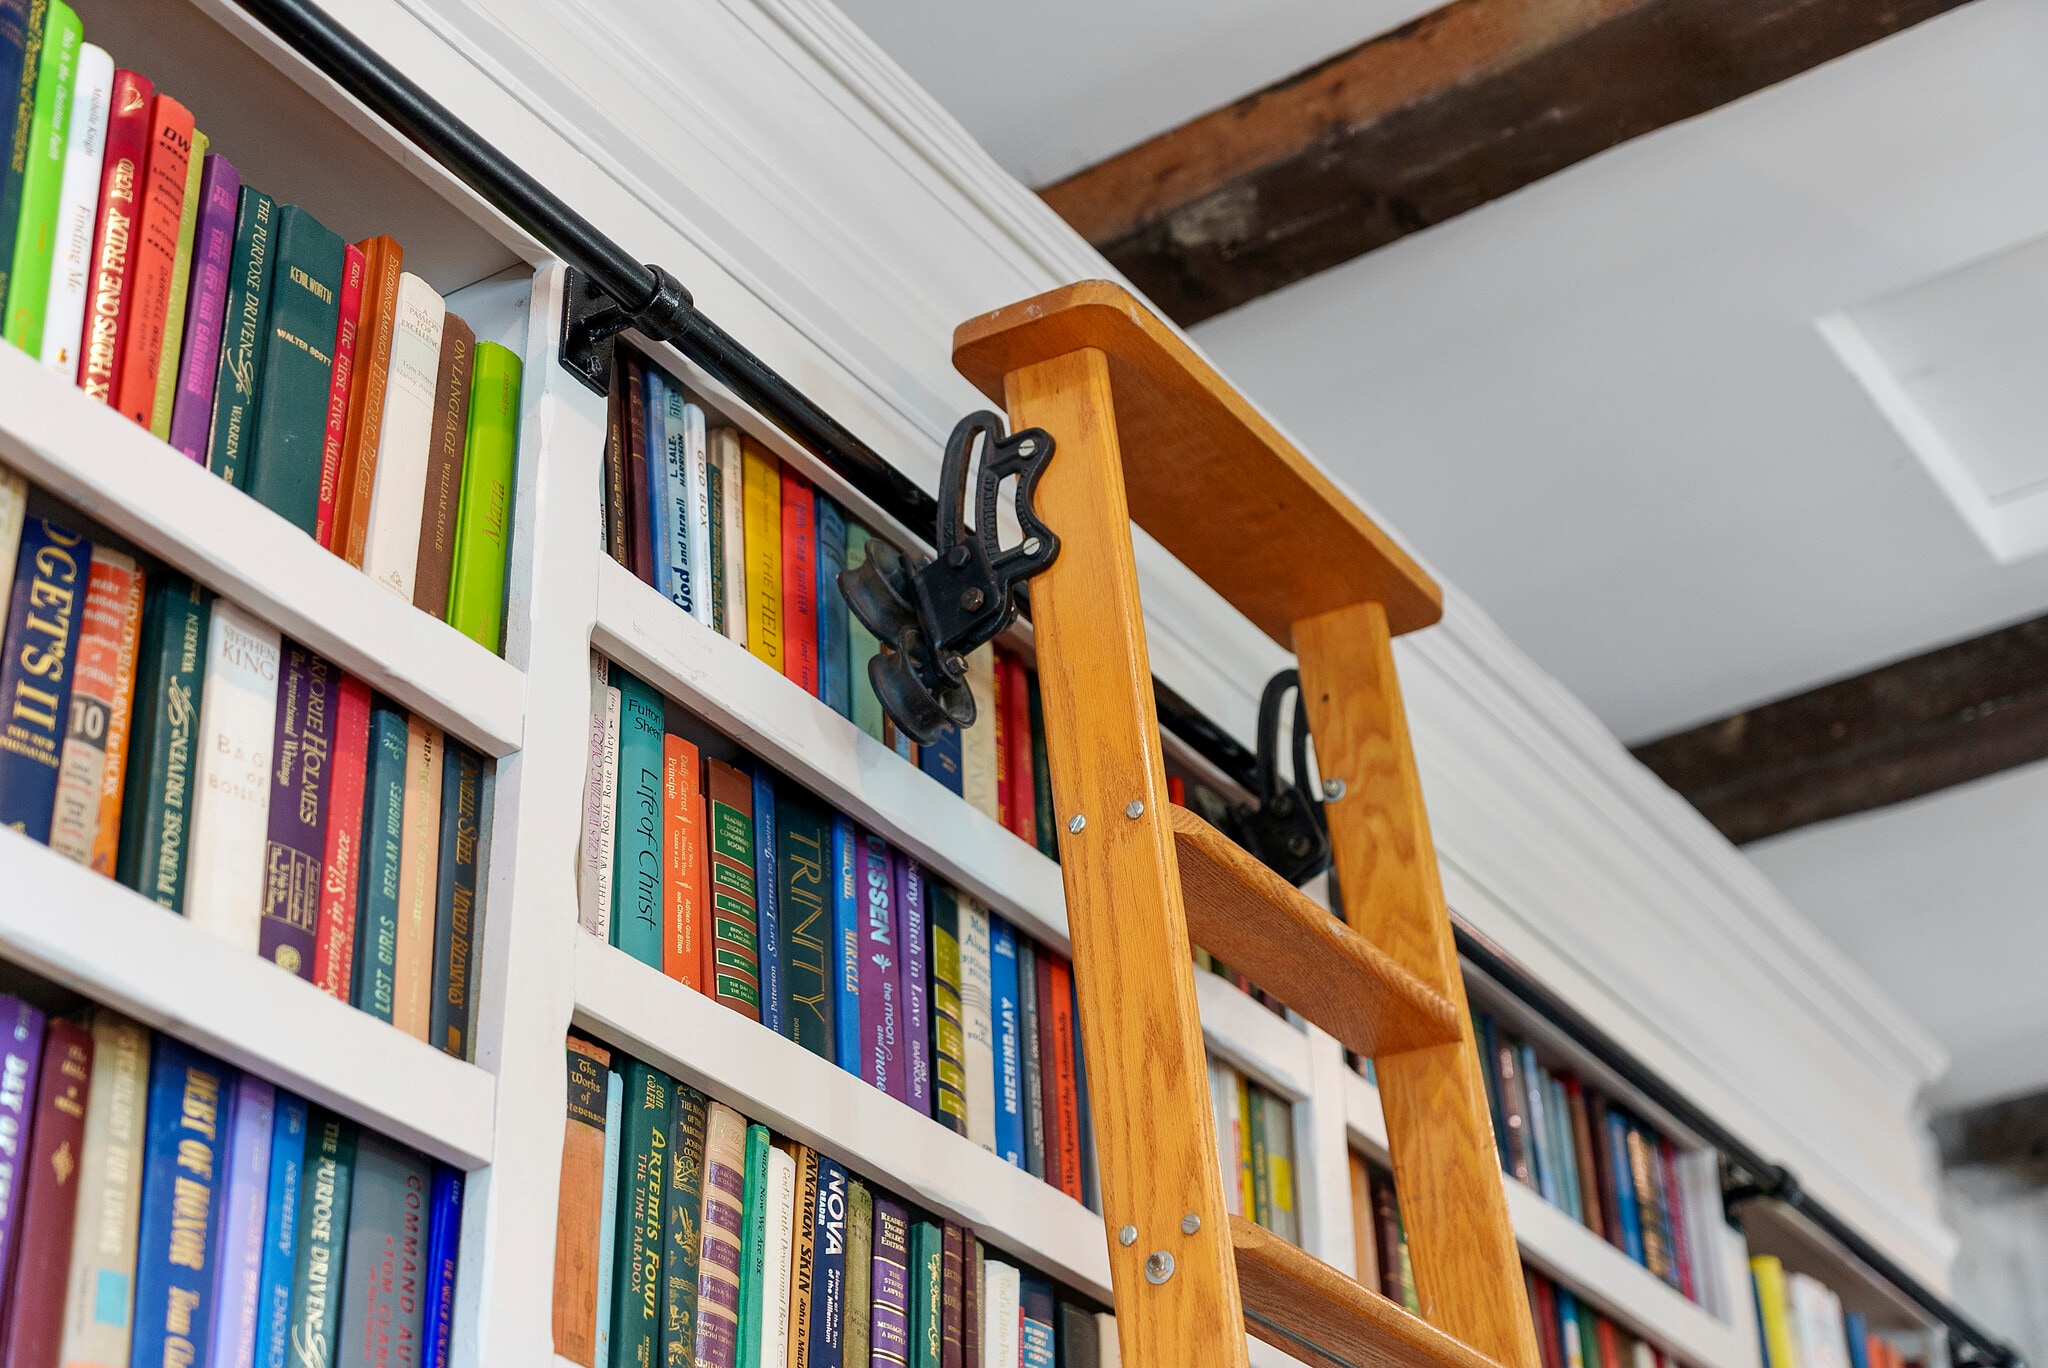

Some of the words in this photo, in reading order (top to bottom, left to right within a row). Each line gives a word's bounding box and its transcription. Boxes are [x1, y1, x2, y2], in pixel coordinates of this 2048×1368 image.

[88, 86, 103, 123] Michelle
[83, 124, 99, 157] Knight
[163, 126, 192, 154] DW
[257, 199, 271, 225] THE
[67, 203, 92, 267] Finding
[102, 207, 130, 275] FRIDAY
[247, 228, 268, 292] PURPOSE
[350, 261, 361, 289] KING
[64, 268, 84, 297] Me
[96, 272, 124, 317] ONE
[290, 265, 333, 305] KENILWORTH
[382, 254, 400, 313] EXPLORING
[239, 291, 260, 356] DRIVEN
[344, 316, 357, 351] The
[375, 311, 393, 364] AMERICA'S
[408, 306, 440, 334] PASSION
[88, 314, 117, 378] HOURS
[277, 328, 309, 352] WALTER
[309, 345, 332, 368] SCOTT
[456, 338, 466, 361] ON
[227, 347, 255, 405] Life
[336, 352, 354, 397] First
[330, 394, 347, 432] Five
[363, 361, 387, 437] HISTORIC
[443, 362, 464, 458] LANGUAGE
[226, 406, 243, 459] WARREN
[668, 435, 679, 466] SALE-
[320, 434, 341, 505] Minutes
[357, 438, 377, 499] PLACES
[438, 462, 452, 508] WILLIAM
[670, 469, 678, 480] L.
[697, 450, 707, 488] GOD
[434, 507, 447, 552] SAFIRE
[482, 478, 506, 549] Maria
[698, 491, 709, 529] BOX
[795, 501, 806, 528] LEAN
[680, 542, 689, 566] and
[796, 535, 807, 562] MEAN
[672, 566, 694, 614] God
[762, 552, 773, 593] THE
[797, 565, 809, 615] THIRTEEN
[181, 613, 200, 674] WARREN
[223, 623, 276, 661] STEPHEN
[761, 589, 777, 659] HELP
[221, 643, 275, 682] KING
[800, 639, 809, 665] Janet
[12, 679, 60, 732] II
[71, 701, 106, 741] 10
[168, 674, 199, 739] Life
[282, 668, 305, 739] Inspirational
[628, 698, 661, 724] Fulton
[604, 732, 616, 766] Daley
[633, 717, 661, 743] Sheen
[164, 733, 189, 808] DRIVEN
[217, 733, 264, 770] BAG
[275, 739, 300, 787] Writings
[679, 754, 689, 778] Daily
[208, 773, 266, 809] BONES
[299, 729, 328, 827] HOLMES
[602, 768, 613, 798] Rosie
[636, 767, 660, 817] Life
[668, 756, 678, 800] Principle
[679, 778, 688, 812] Carrot
[387, 781, 403, 840] HUGHES
[601, 799, 612, 837] ROSIE
[457, 815, 478, 865] STEEL
[636, 820, 659, 849] of
[727, 840, 746, 855] BOOKS
[765, 813, 778, 860] JENNIFER
[157, 818, 183, 898] PURPOSE
[325, 830, 352, 901] Silence
[383, 839, 401, 900] DECLAN
[600, 837, 609, 875] WITH
[767, 861, 774, 872] TO
[453, 881, 473, 936] MIXED
[597, 875, 609, 928] KITCHEN
[635, 848, 660, 932] Christ
[684, 898, 692, 921] Adrian
[766, 874, 777, 922] LETTERS
[866, 834, 892, 946] DESSEN
[326, 901, 347, 925] in
[676, 905, 685, 935] Chester
[789, 828, 826, 1023] TRINITY
[907, 908, 922, 956] Bitch
[378, 914, 396, 966] GIRLS
[676, 935, 684, 955] Elton
[684, 922, 692, 954] Gostick
[766, 923, 778, 957] SAM'S
[448, 936, 469, 1010] BLESSINGS
[844, 927, 859, 996] MIRACLE
[910, 960, 920, 978] in
[374, 967, 393, 1015] LOST
[770, 966, 779, 1012] Patterson
[884, 982, 893, 1000] the
[910, 982, 923, 1028] Love
[876, 1024, 884, 1048] and
[884, 1000, 896, 1046] moon
[577, 1058, 597, 1078] The
[874, 1043, 894, 1093] more
[911, 1040, 923, 1099] BARNOUIN
[919, 1060, 928, 1083] KIM
[1001, 996, 1017, 1115] MOCKINGJAY
[571, 1069, 601, 1093] Works
[581, 1091, 592, 1106] of
[642, 1074, 657, 1110] COLFER
[655, 1082, 666, 1109] EOIN
[180, 1066, 220, 1142] DEBT
[322, 1122, 340, 1155] THE
[177, 1138, 214, 1181] OF
[637, 1154, 648, 1178] THE
[761, 1148, 769, 1172] MILNE
[311, 1154, 337, 1244] PURPOSE
[634, 1182, 645, 1213] TIME
[760, 1184, 768, 1205] Now
[782, 1166, 791, 1197] God's
[169, 1175, 211, 1271] HONOR
[279, 1160, 297, 1257] ARTERBURN
[759, 1213, 767, 1232] We
[781, 1202, 789, 1235] Little
[817, 1189, 827, 1226] READER
[825, 1168, 847, 1256] NOVA
[399, 1174, 423, 1315] COMMAND
[757, 1237, 765, 1253] Are
[883, 1229, 905, 1244] SELECT
[884, 1220, 905, 1236] DIGEST
[382, 1249, 396, 1294] TOM
[631, 1219, 644, 1295] PARADOX
[779, 1235, 788, 1301] Devotional
[798, 1243, 812, 1294] SKIN
[828, 1268, 834, 1281] of
[888, 1269, 900, 1280] THE
[305, 1243, 330, 1329] DRIVEN
[642, 1246, 661, 1321] FOWL
[883, 1276, 904, 1290] STREET
[165, 1285, 201, 1337] Tom
[777, 1305, 786, 1337] Book
[798, 1297, 808, 1326] John
[825, 1298, 833, 1344] Millennium
[876, 1320, 902, 1335] MESSAGE
[797, 1327, 806, 1340] D.
